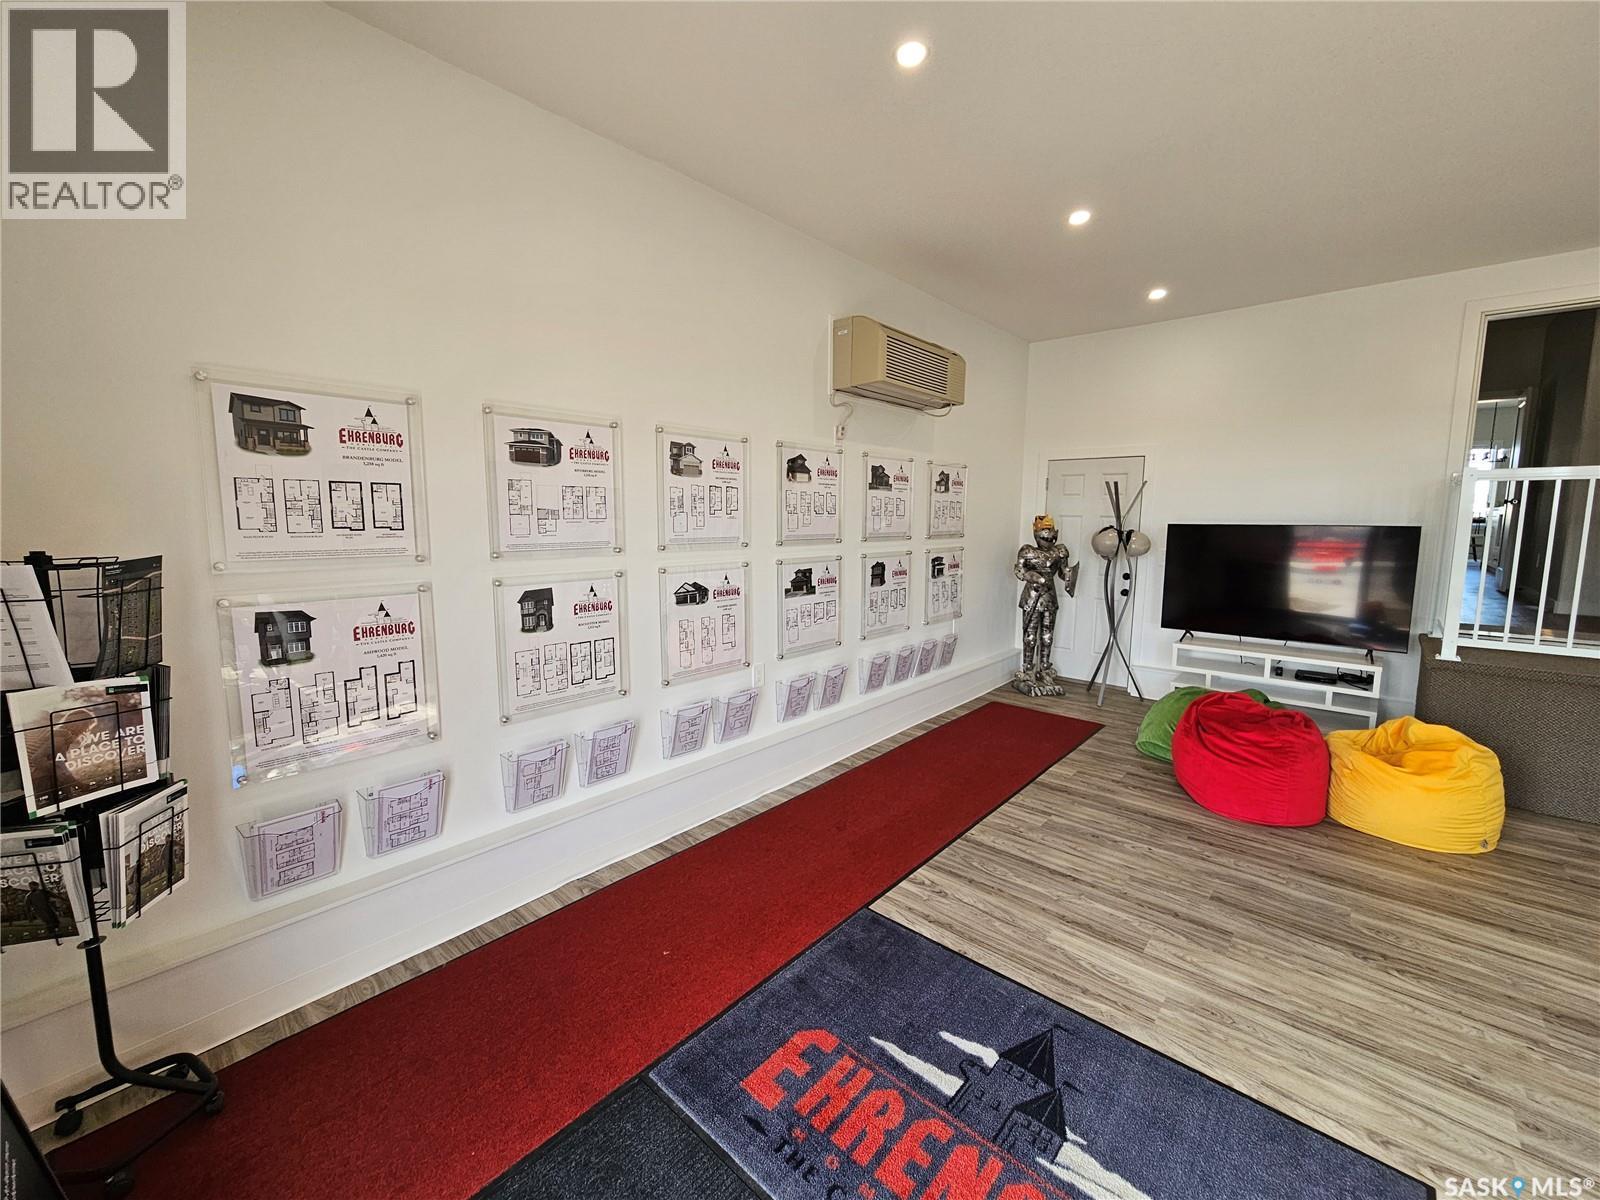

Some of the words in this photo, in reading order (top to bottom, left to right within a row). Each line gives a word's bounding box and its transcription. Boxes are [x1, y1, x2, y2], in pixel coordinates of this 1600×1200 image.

[339, 427, 404, 448] EHRENBURG
[569, 447, 610, 462] EHRENBURG
[573, 600, 613, 616] EHRENBURG
[353, 621, 416, 642] EHRENBURG
[115, 725, 145, 738] ARE
[55, 752, 66, 762] A
[70, 739, 120, 759] PLACE
[124, 734, 145, 746] TO
[65, 744, 146, 772] DISCOVER
[740, 1029, 1048, 1200] EHREN
